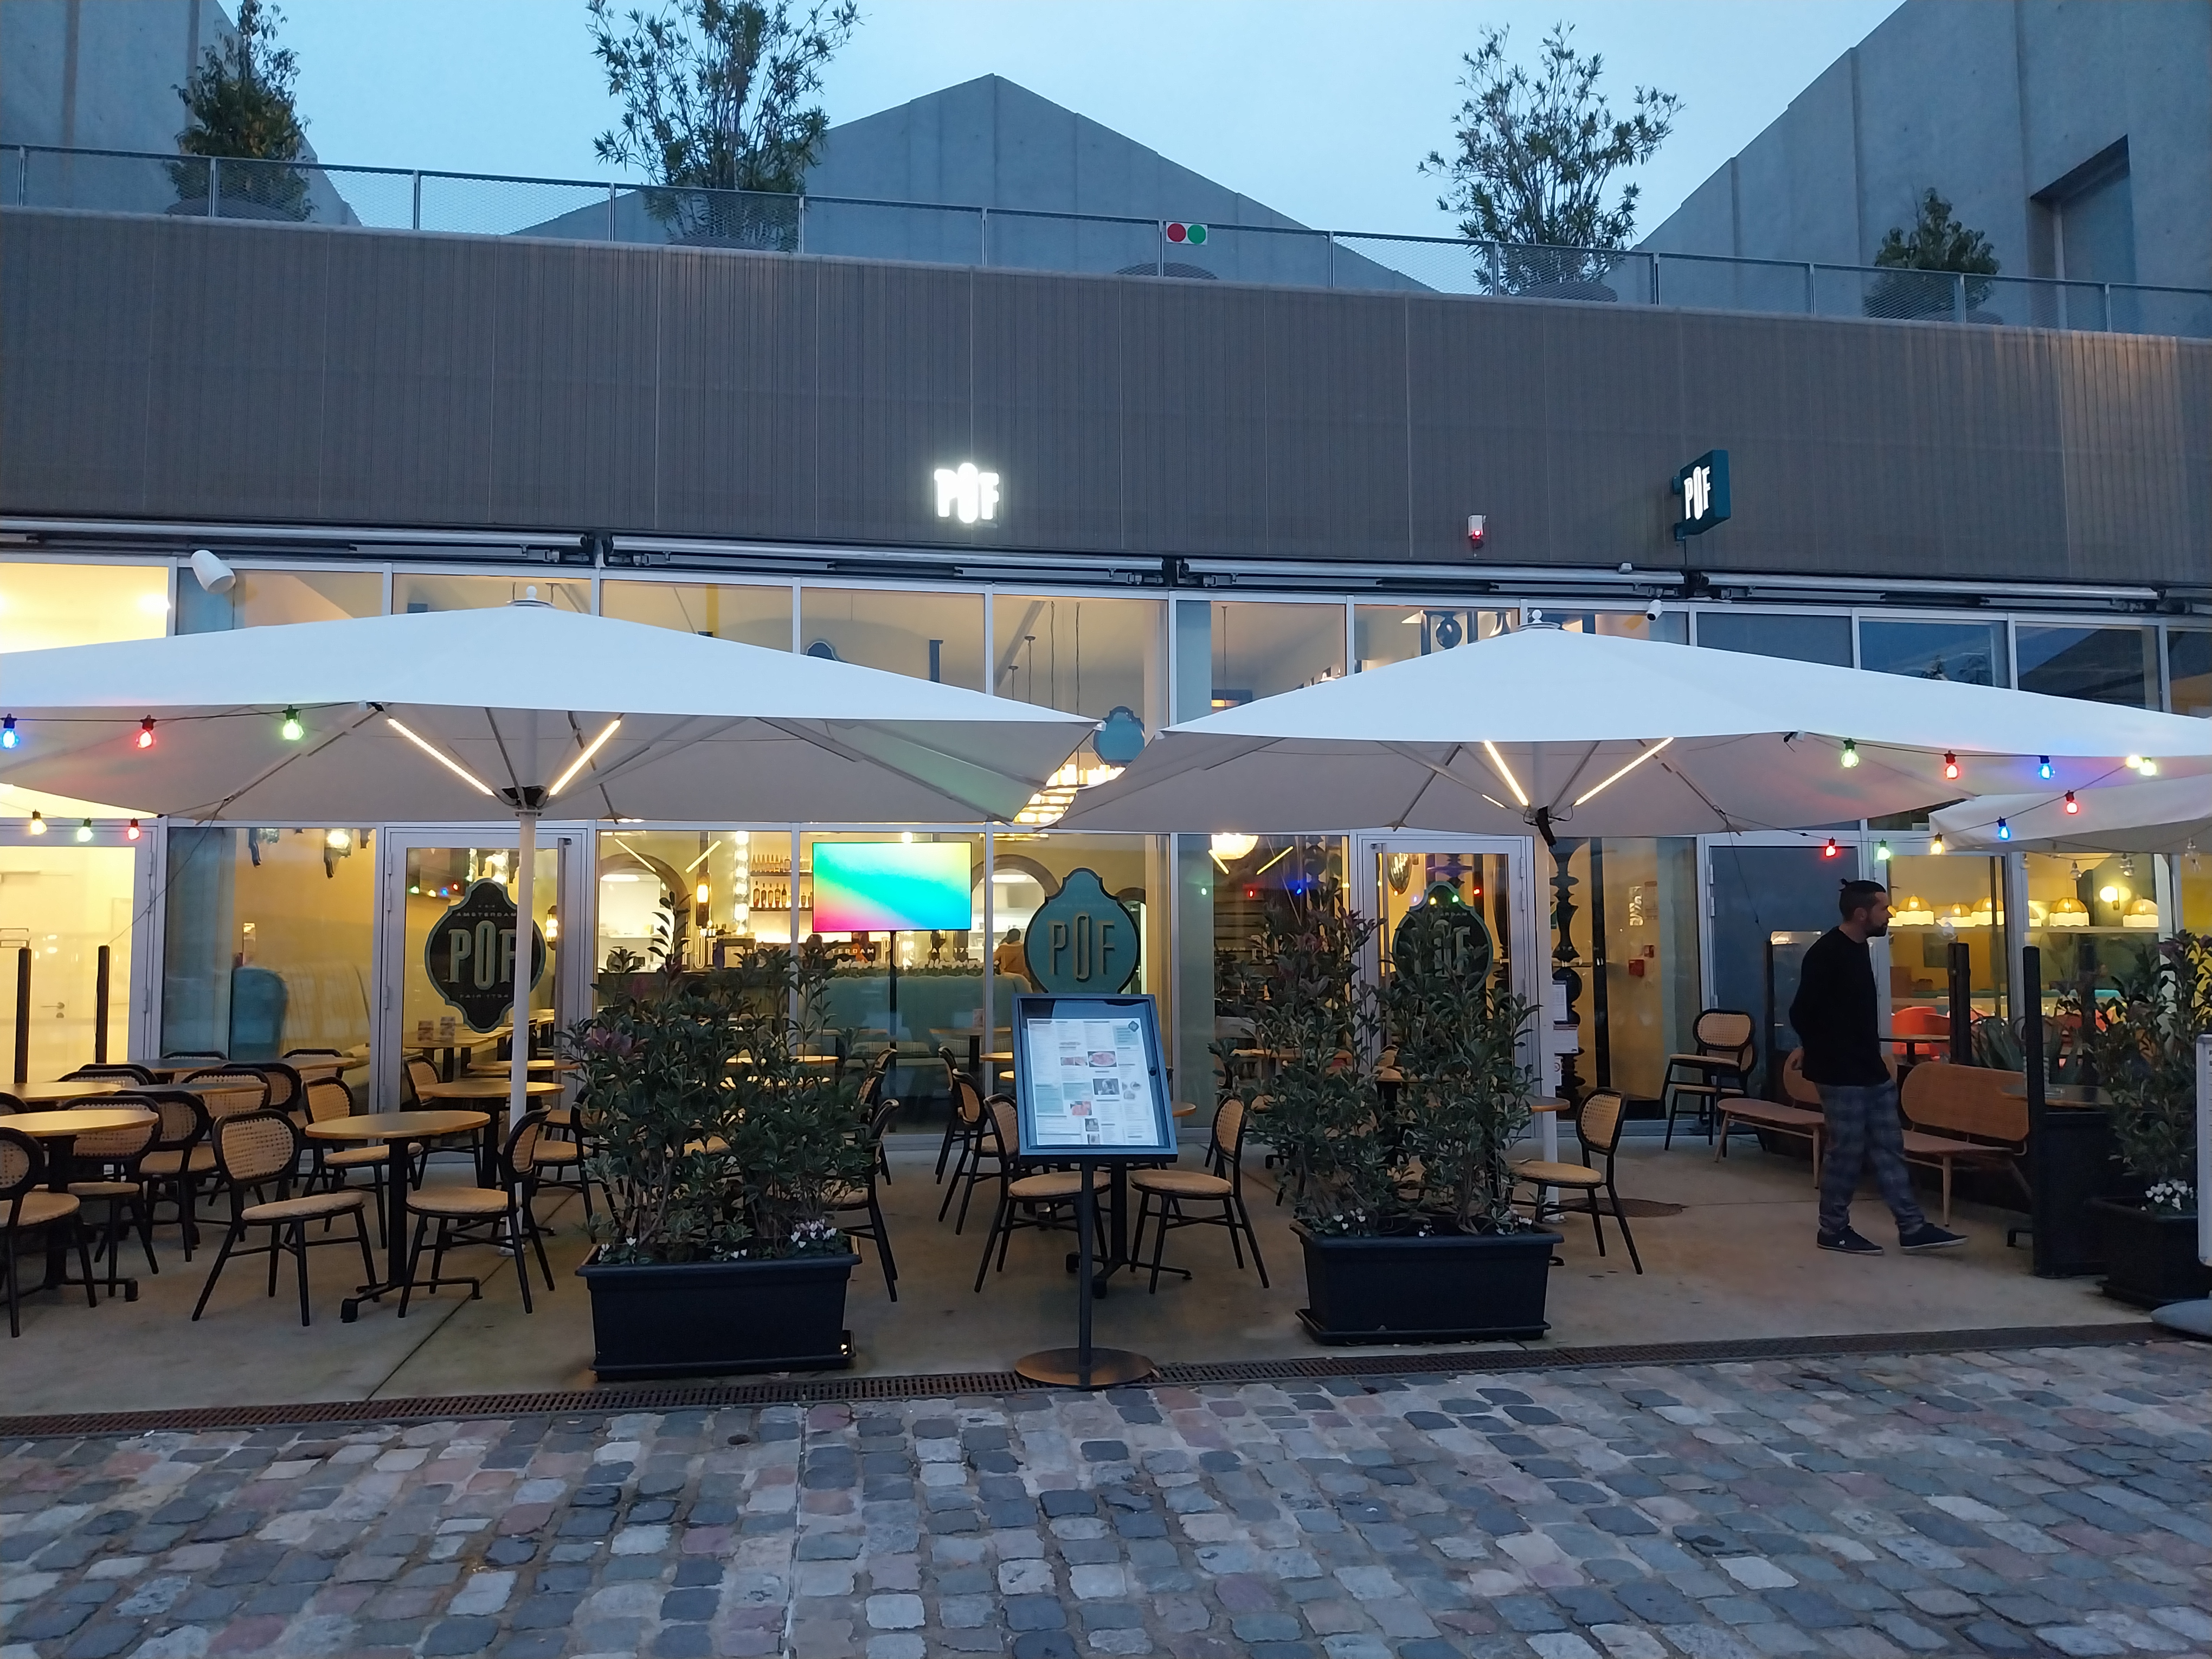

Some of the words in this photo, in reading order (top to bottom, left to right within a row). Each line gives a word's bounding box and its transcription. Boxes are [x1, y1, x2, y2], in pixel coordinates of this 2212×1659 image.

[934, 462, 999, 523] POF
[1684, 466, 1711, 520] POF
[448, 920, 517, 990] POF
[1047, 911, 1115, 982] POF
